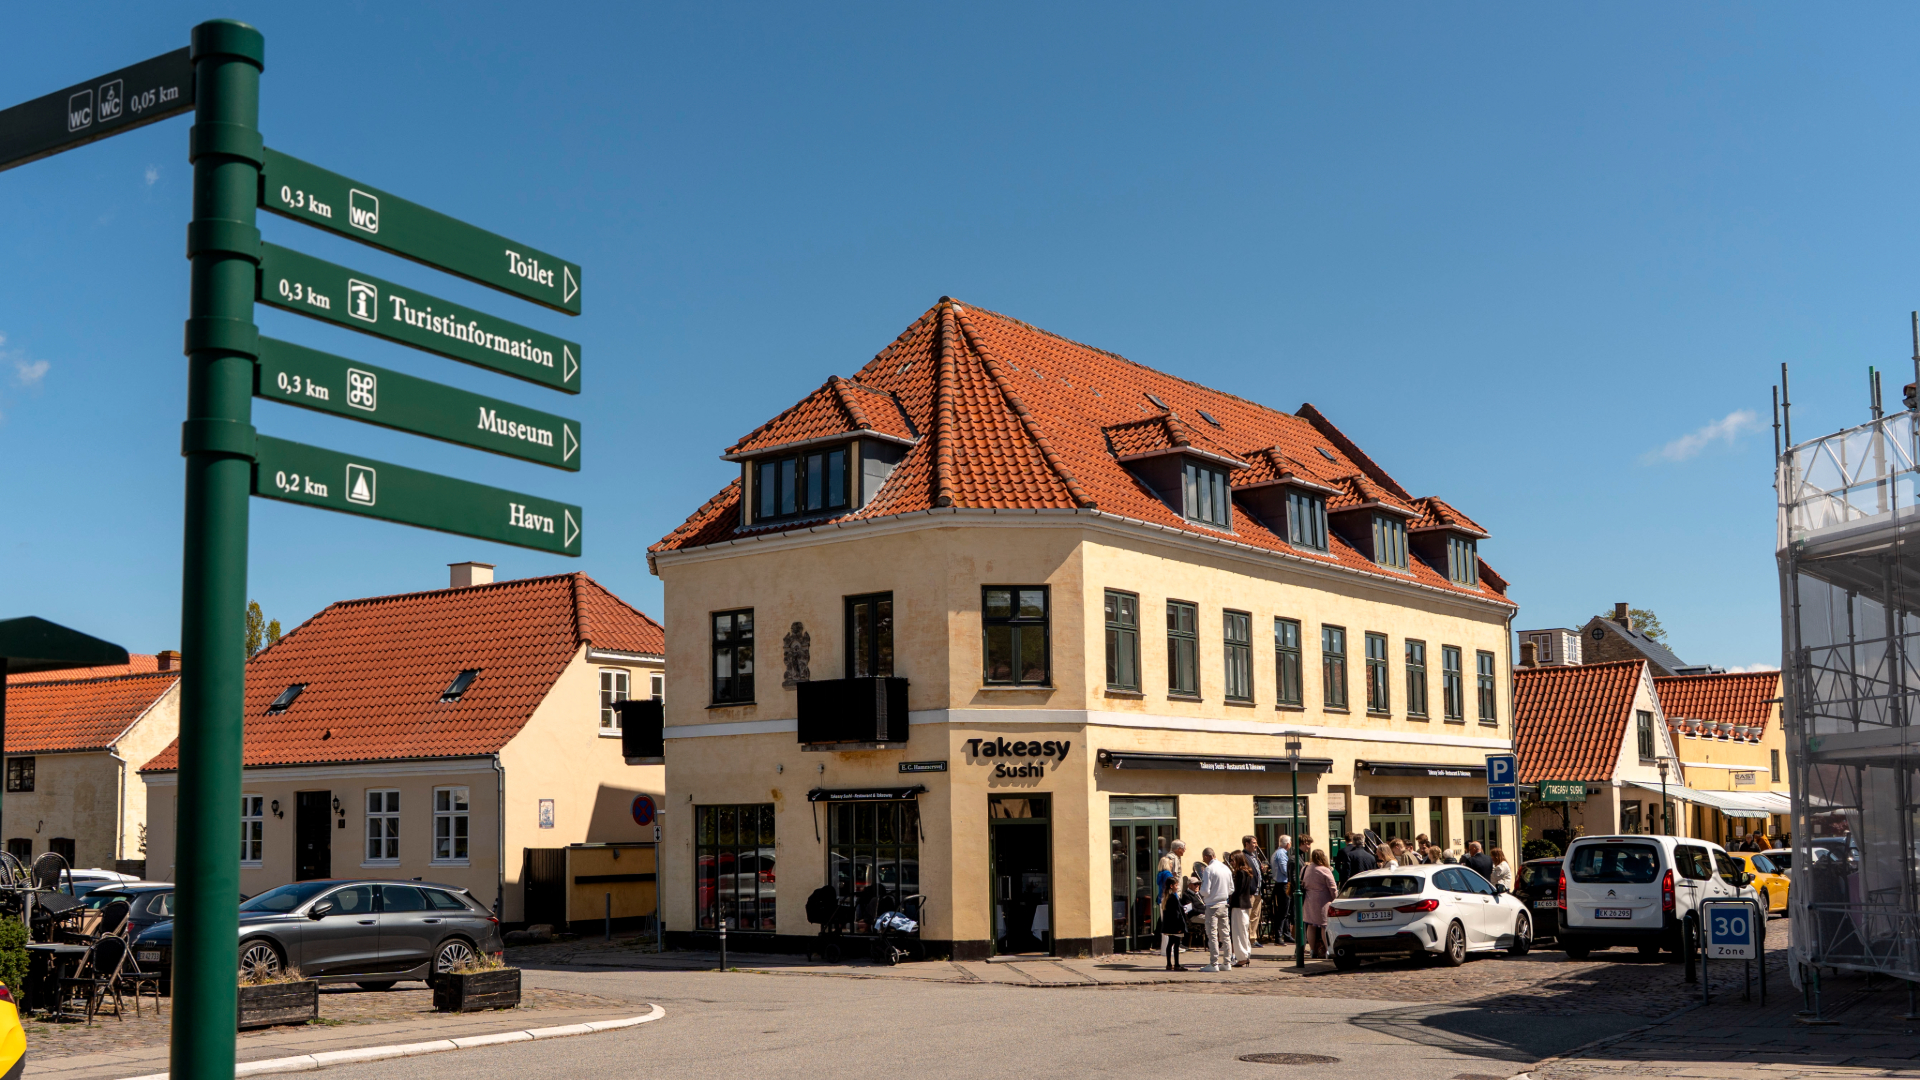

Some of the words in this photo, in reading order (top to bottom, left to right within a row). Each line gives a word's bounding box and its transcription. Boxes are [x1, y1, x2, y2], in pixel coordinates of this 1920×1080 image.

[70, 108, 91, 128] WC
[101, 98, 120, 117] WC
[131, 89, 156, 114] 0,05
[159, 86, 179, 103] km
[281, 185, 305, 208] 0,3
[308, 194, 332, 218] km
[352, 206, 377, 230] WC
[505, 250, 554, 288] Toilet
[279, 278, 303, 301] 0,3
[307, 286, 331, 310] km
[389, 295, 554, 367] Turistinformation
[277, 372, 301, 394] 0,3
[305, 378, 329, 400] km
[477, 406, 554, 447] Museum
[276, 471, 300, 493] 0,2
[304, 476, 328, 497] km
[508, 502, 554, 534] Havn
[967, 736, 1071, 762] Takeasy
[995, 761, 1044, 778] Sushi
[1493, 760, 1508, 781] P
[1570, 785, 1583, 795] SUSHI
[1715, 917, 1746, 936] 30
[1718, 946, 1745, 955] Zone
